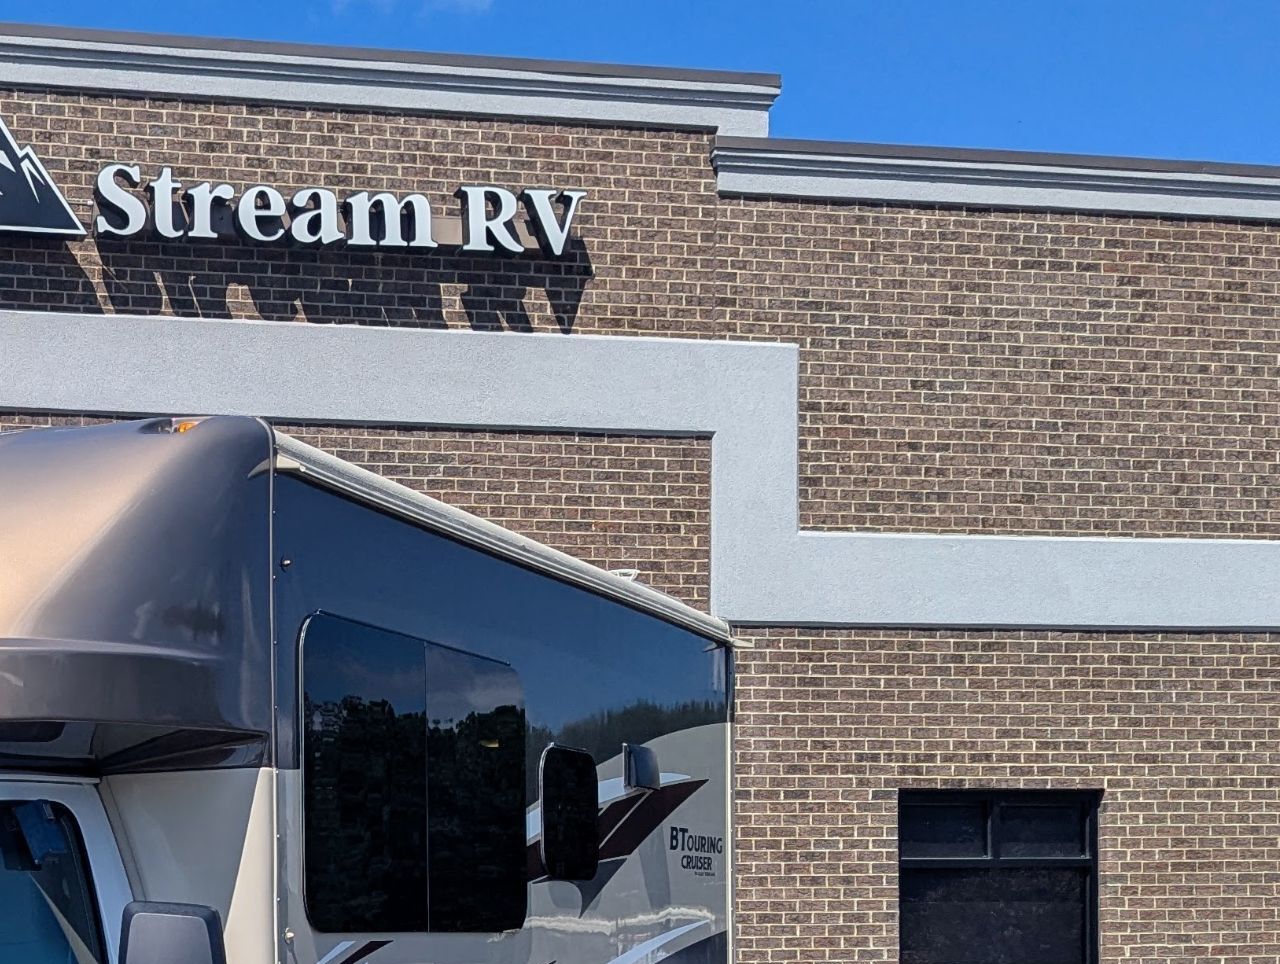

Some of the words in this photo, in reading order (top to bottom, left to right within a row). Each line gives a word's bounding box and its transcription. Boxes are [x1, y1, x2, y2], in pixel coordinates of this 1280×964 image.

[96, 163, 438, 249] Stream
[459, 185, 588, 257] RV
[681, 854, 713, 871] CRUISER
